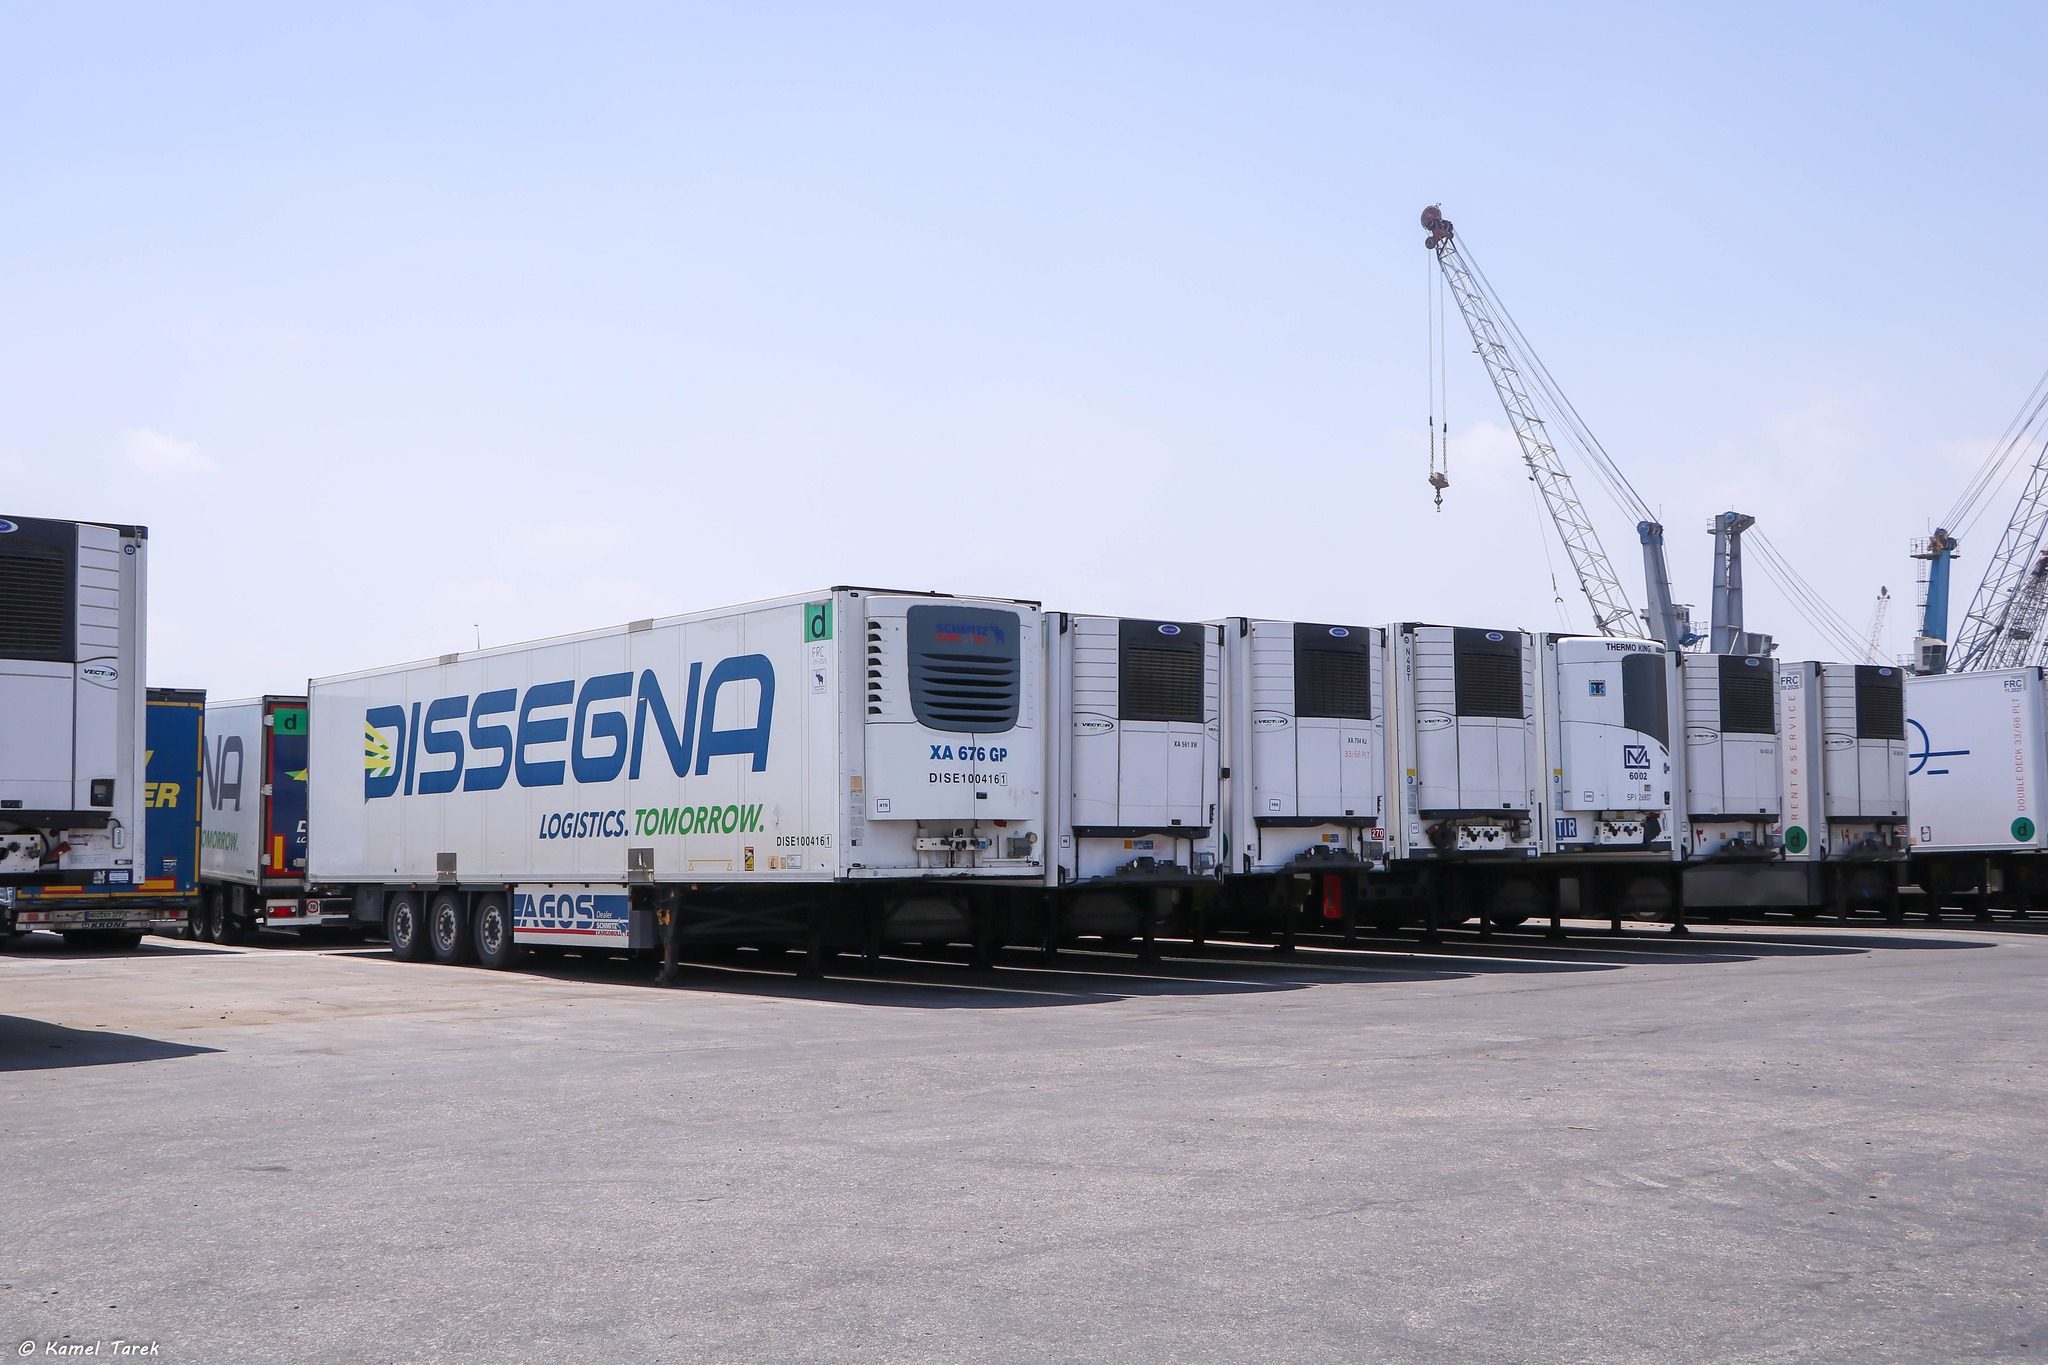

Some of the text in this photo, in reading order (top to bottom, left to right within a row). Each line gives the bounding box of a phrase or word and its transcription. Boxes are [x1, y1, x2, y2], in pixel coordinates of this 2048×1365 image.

[811, 604, 826, 638] d
[811, 646, 825, 658] FRC
[1605, 643, 1637, 652] THERMO
[84, 668, 116, 678] VECTOR
[1780, 676, 1799, 686] FRC
[2003, 679, 2022, 689] FRC
[284, 713, 297, 730] d
[364, 653, 776, 804] DISSEGNA
[1787, 694, 1798, 762] SERVICE
[929, 745, 1008, 762] XA 676 GP
[2015, 750, 2024, 774] DECK
[929, 772, 1008, 786] DISE1004161
[1629, 772, 1648, 780] 6002
[2016, 776, 2026, 812] DOUBLE
[1791, 783, 1799, 821] RENT
[539, 803, 765, 839] LOGISTICS. TOMORROW.
[1556, 818, 1577, 837] TIR
[1371, 829, 1384, 838] 270
[2017, 822, 2028, 837] d
[776, 834, 832, 848] DISE1004161
[1790, 831, 1800, 846] d
[596, 910, 613, 919] Dealer
[91, 921, 128, 929] KRONE
